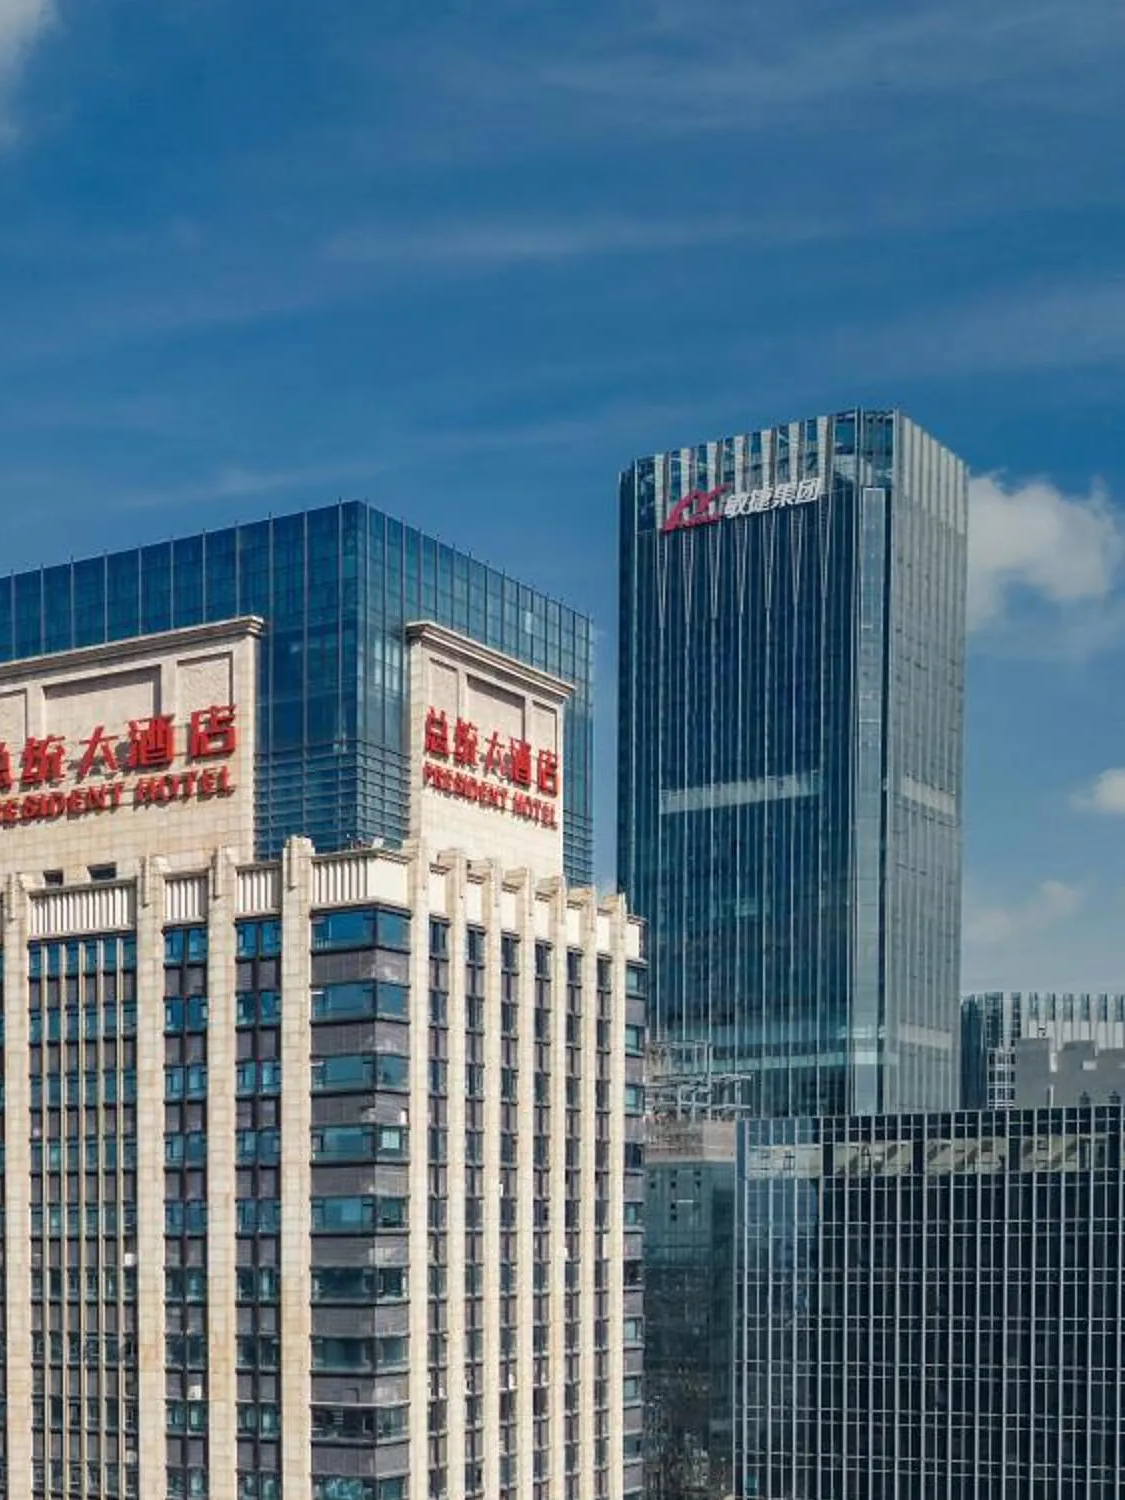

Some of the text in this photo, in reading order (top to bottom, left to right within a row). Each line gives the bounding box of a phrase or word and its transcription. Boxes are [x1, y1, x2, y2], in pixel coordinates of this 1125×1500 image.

[137, 765, 234, 802] HOTEL
[425, 705, 557, 796] 总统大酒店
[424, 761, 557, 828] PRESIDENT HOTEL
